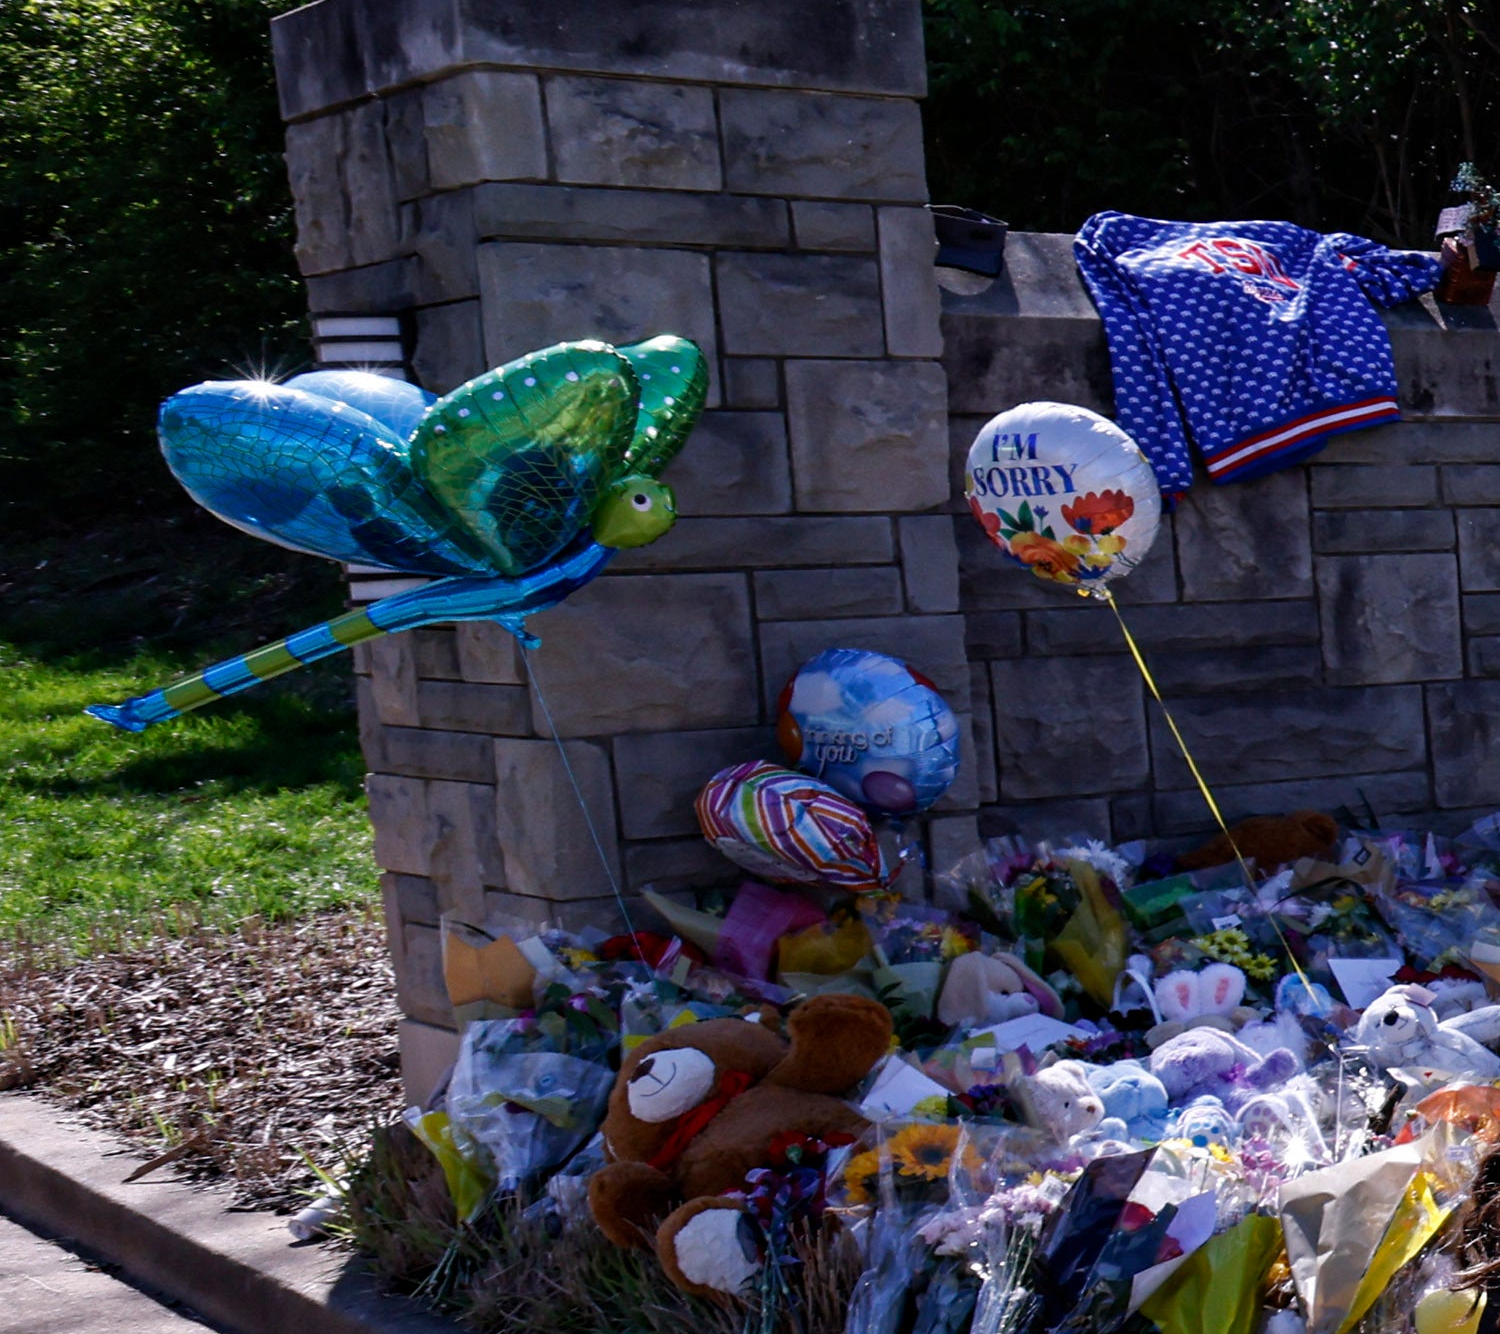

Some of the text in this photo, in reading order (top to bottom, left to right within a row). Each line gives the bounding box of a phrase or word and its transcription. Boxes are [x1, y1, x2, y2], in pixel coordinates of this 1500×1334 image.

[991, 432, 1041, 463] I'M
[972, 463, 1079, 498] SORRY
[873, 726, 895, 746] of
[815, 745, 858, 777] you
